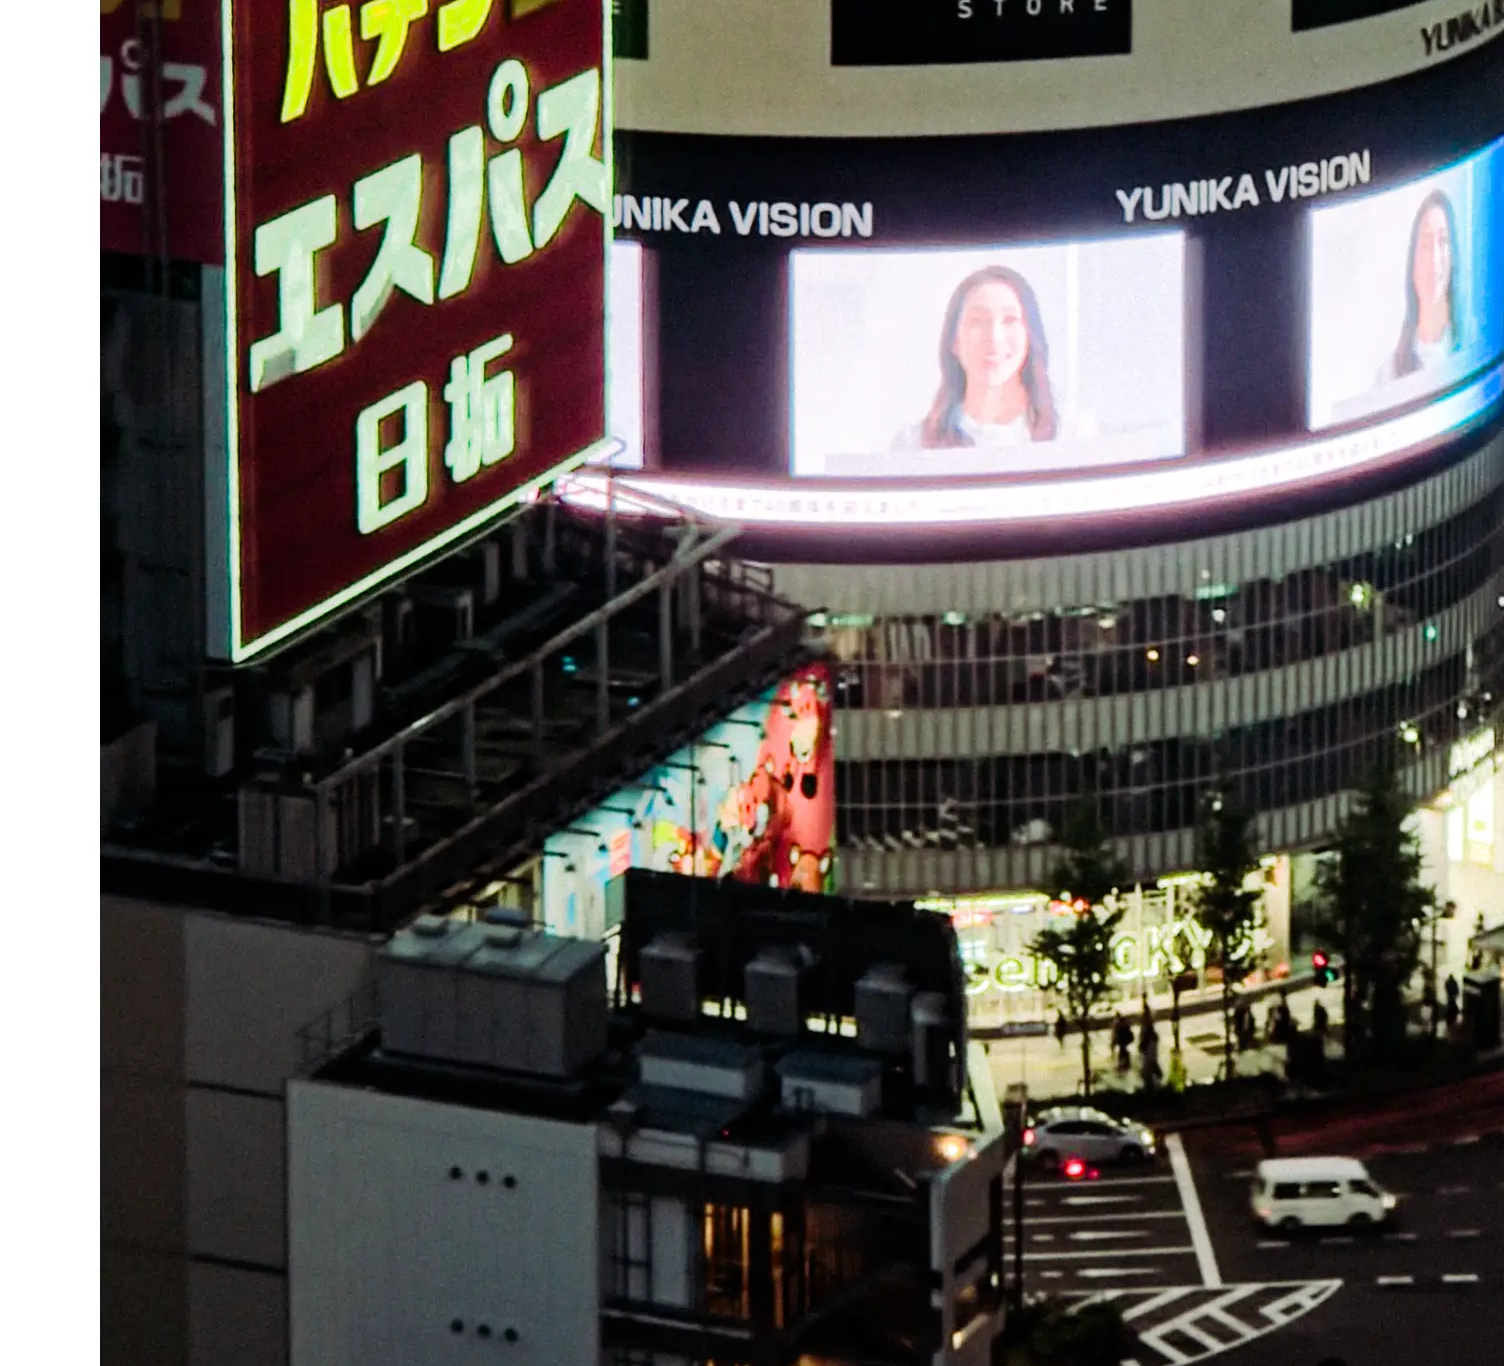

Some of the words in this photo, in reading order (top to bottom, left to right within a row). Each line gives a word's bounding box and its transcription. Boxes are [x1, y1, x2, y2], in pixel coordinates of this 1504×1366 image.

[728, 200, 873, 238] VISION
[1115, 172, 1260, 223] YUNIKA
[1265, 148, 1371, 204] VISION
[249, 57, 612, 393] エスパス
